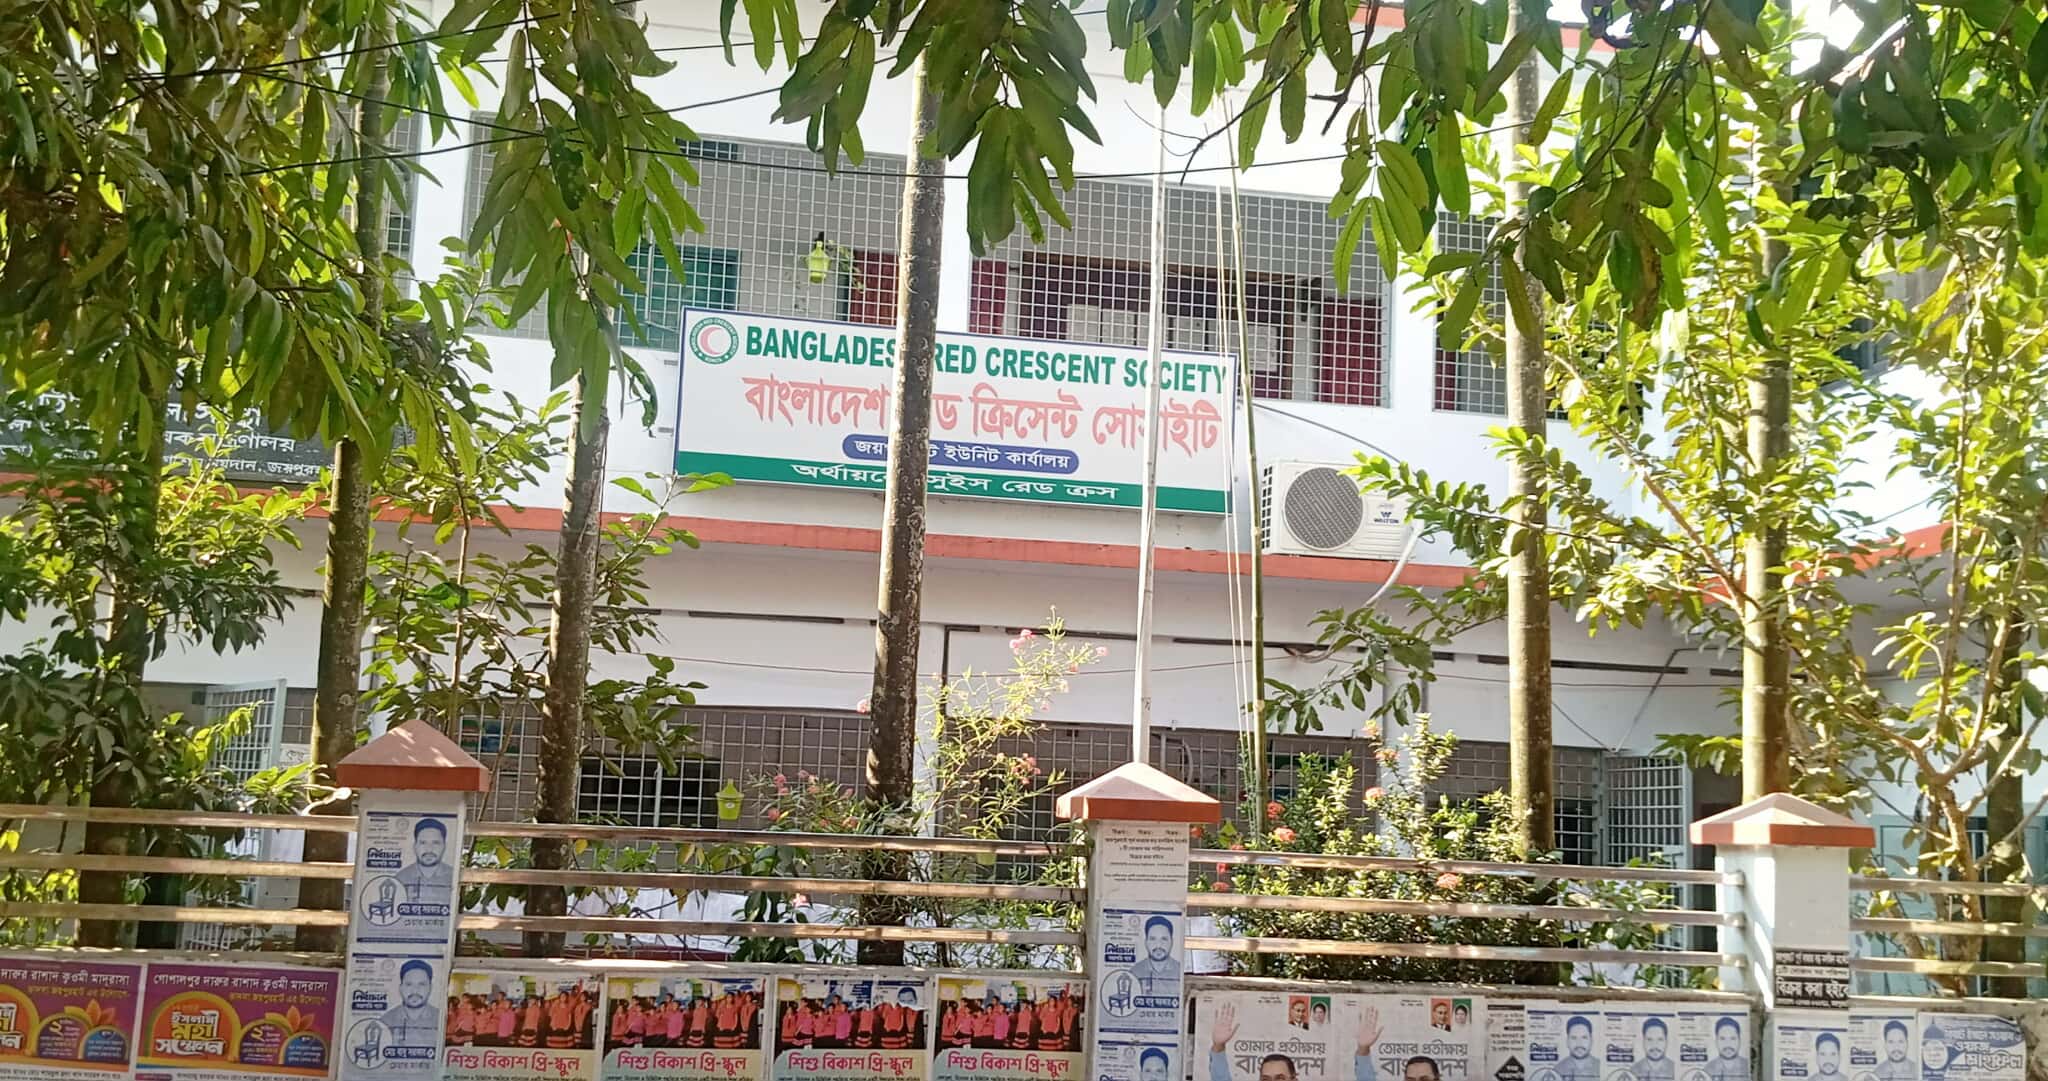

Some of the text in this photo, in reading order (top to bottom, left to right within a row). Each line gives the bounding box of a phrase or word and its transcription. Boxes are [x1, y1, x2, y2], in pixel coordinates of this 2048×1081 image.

[746, 326, 896, 368] BANGLADES
[934, 342, 977, 374] RED
[985, 347, 1116, 385] CRESCENT
[741, 373, 891, 431] বাংলাদেশ
[968, 382, 1084, 443] ক্রিসেন্ট
[944, 442, 1001, 464] ইউনিট
[1005, 449, 1072, 470] কার্যালয়
[927, 473, 993, 492] সুইস
[1002, 479, 1057, 496] রেড
[1065, 483, 1120, 500] ক্রস
[1233, 1039, 1275, 1053] তোমার
[1378, 1042, 1418, 1055] তোমার
[446, 1049, 479, 1069] শিশু
[483, 1050, 528, 1069] বিকাশ
[617, 1049, 649, 1070] শিশু
[652, 1050, 697, 1069] বিকাশ
[788, 1051, 819, 1071] শিশু
[822, 1051, 865, 1071] বিকাশ
[947, 1050, 978, 1071] শিশু
[981, 1052, 1022, 1071] বিকাশ
